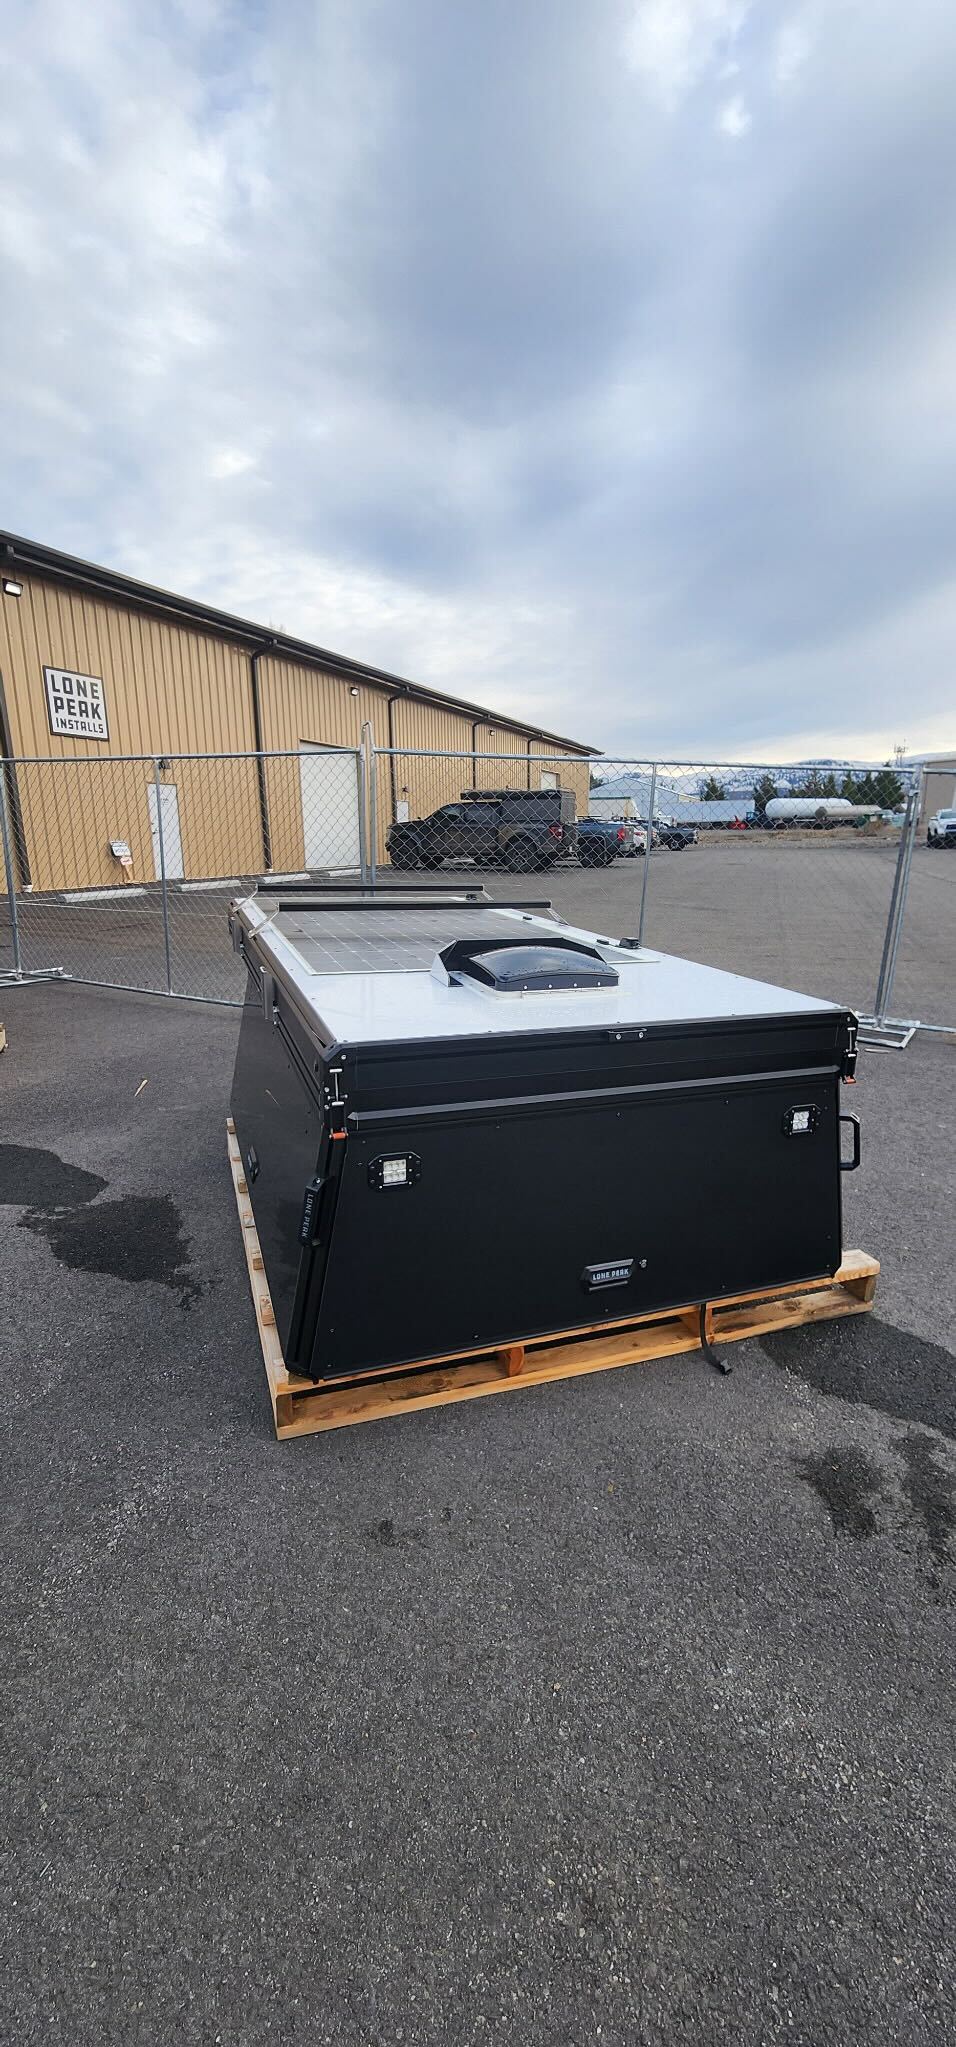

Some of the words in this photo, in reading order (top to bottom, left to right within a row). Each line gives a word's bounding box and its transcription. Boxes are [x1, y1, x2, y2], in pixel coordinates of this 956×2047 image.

[51, 674, 99, 700] LONE
[53, 696, 102, 720] PEAK
[56, 717, 103, 733] INSTALLS
[305, 1194, 313, 1215] LONE
[302, 1216, 310, 1237] PEAK
[593, 1272, 610, 1280] LONE
